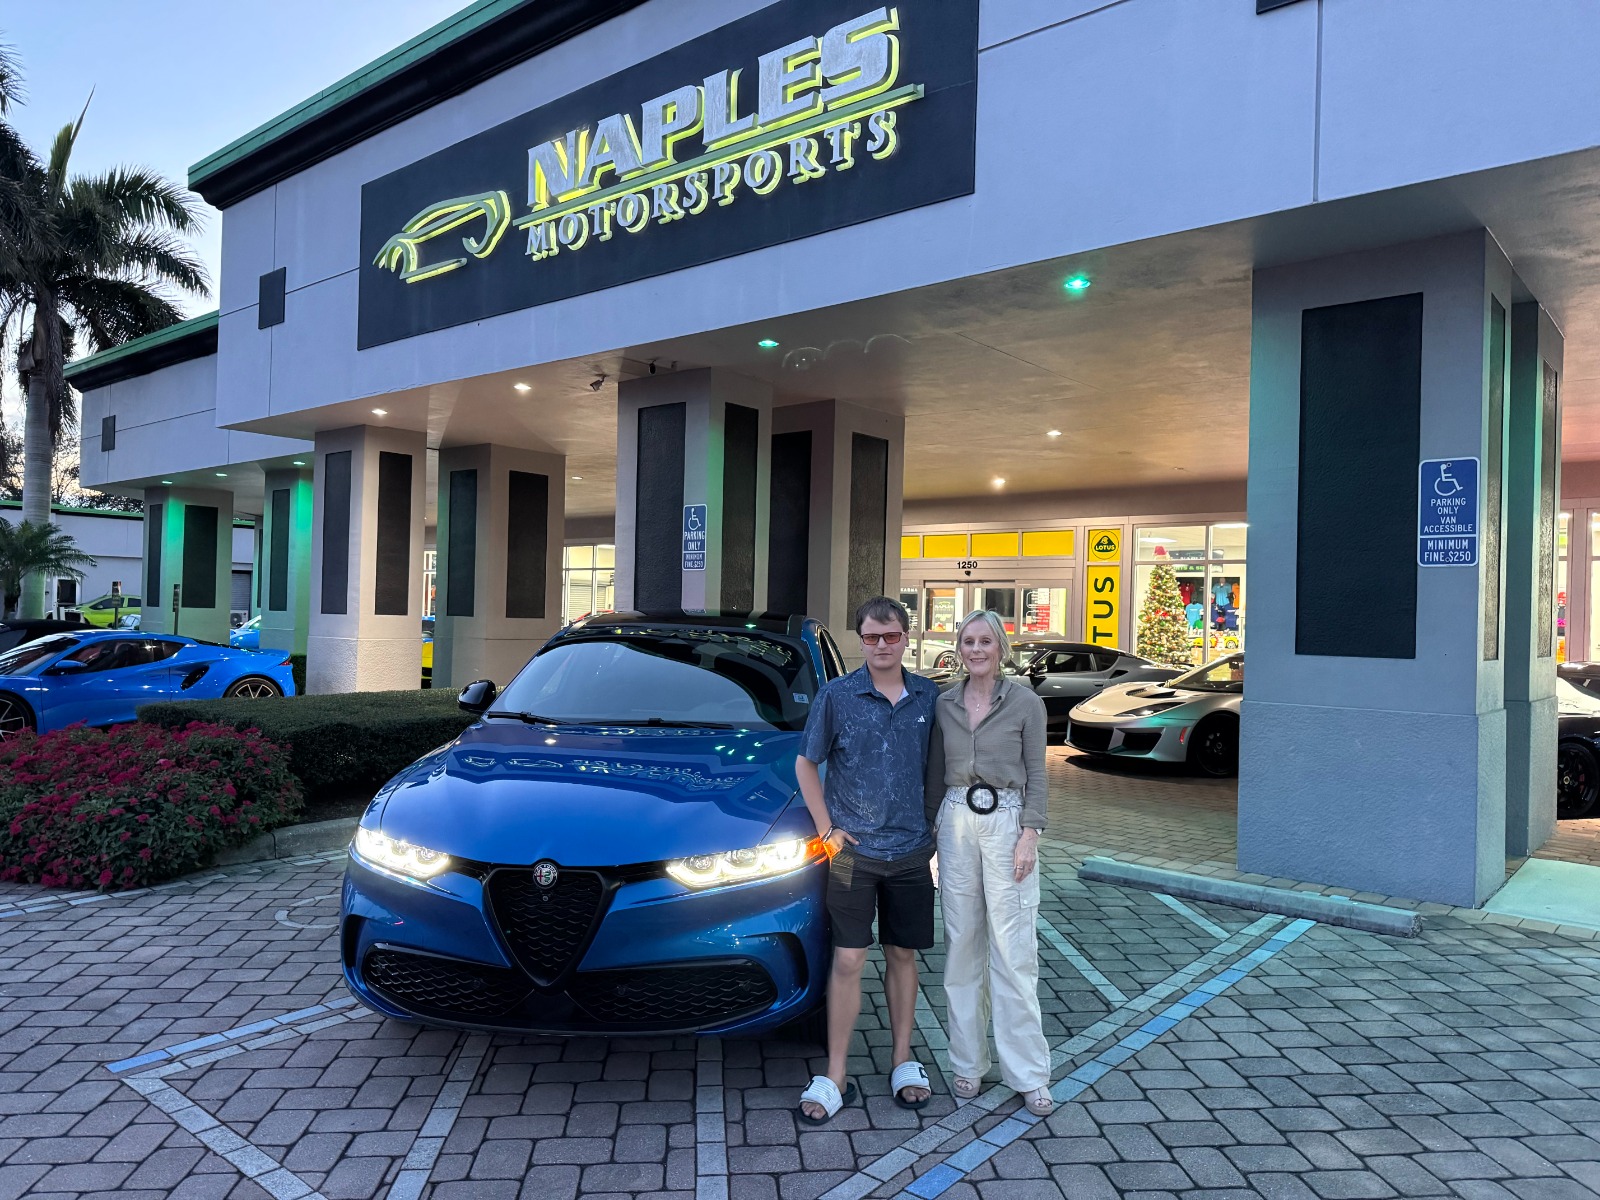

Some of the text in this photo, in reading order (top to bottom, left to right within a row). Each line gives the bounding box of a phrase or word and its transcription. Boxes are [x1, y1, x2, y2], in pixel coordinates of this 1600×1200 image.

[527, 6, 900, 208] NAPLES
[525, 110, 898, 261] MOTORSPORTS
[1431, 498, 1466, 507] PARKING
[1438, 506, 1458, 514] ONLY
[1440, 516, 1456, 524] VAN
[1423, 524, 1473, 533] ACCESSIBLE
[684, 531, 705, 540] PARKING
[688, 541, 701, 550] ONLY
[1428, 540, 1468, 550] MINIMUM
[1425, 551, 1471, 562] FINE $250
[957, 561, 978, 569] 1250
